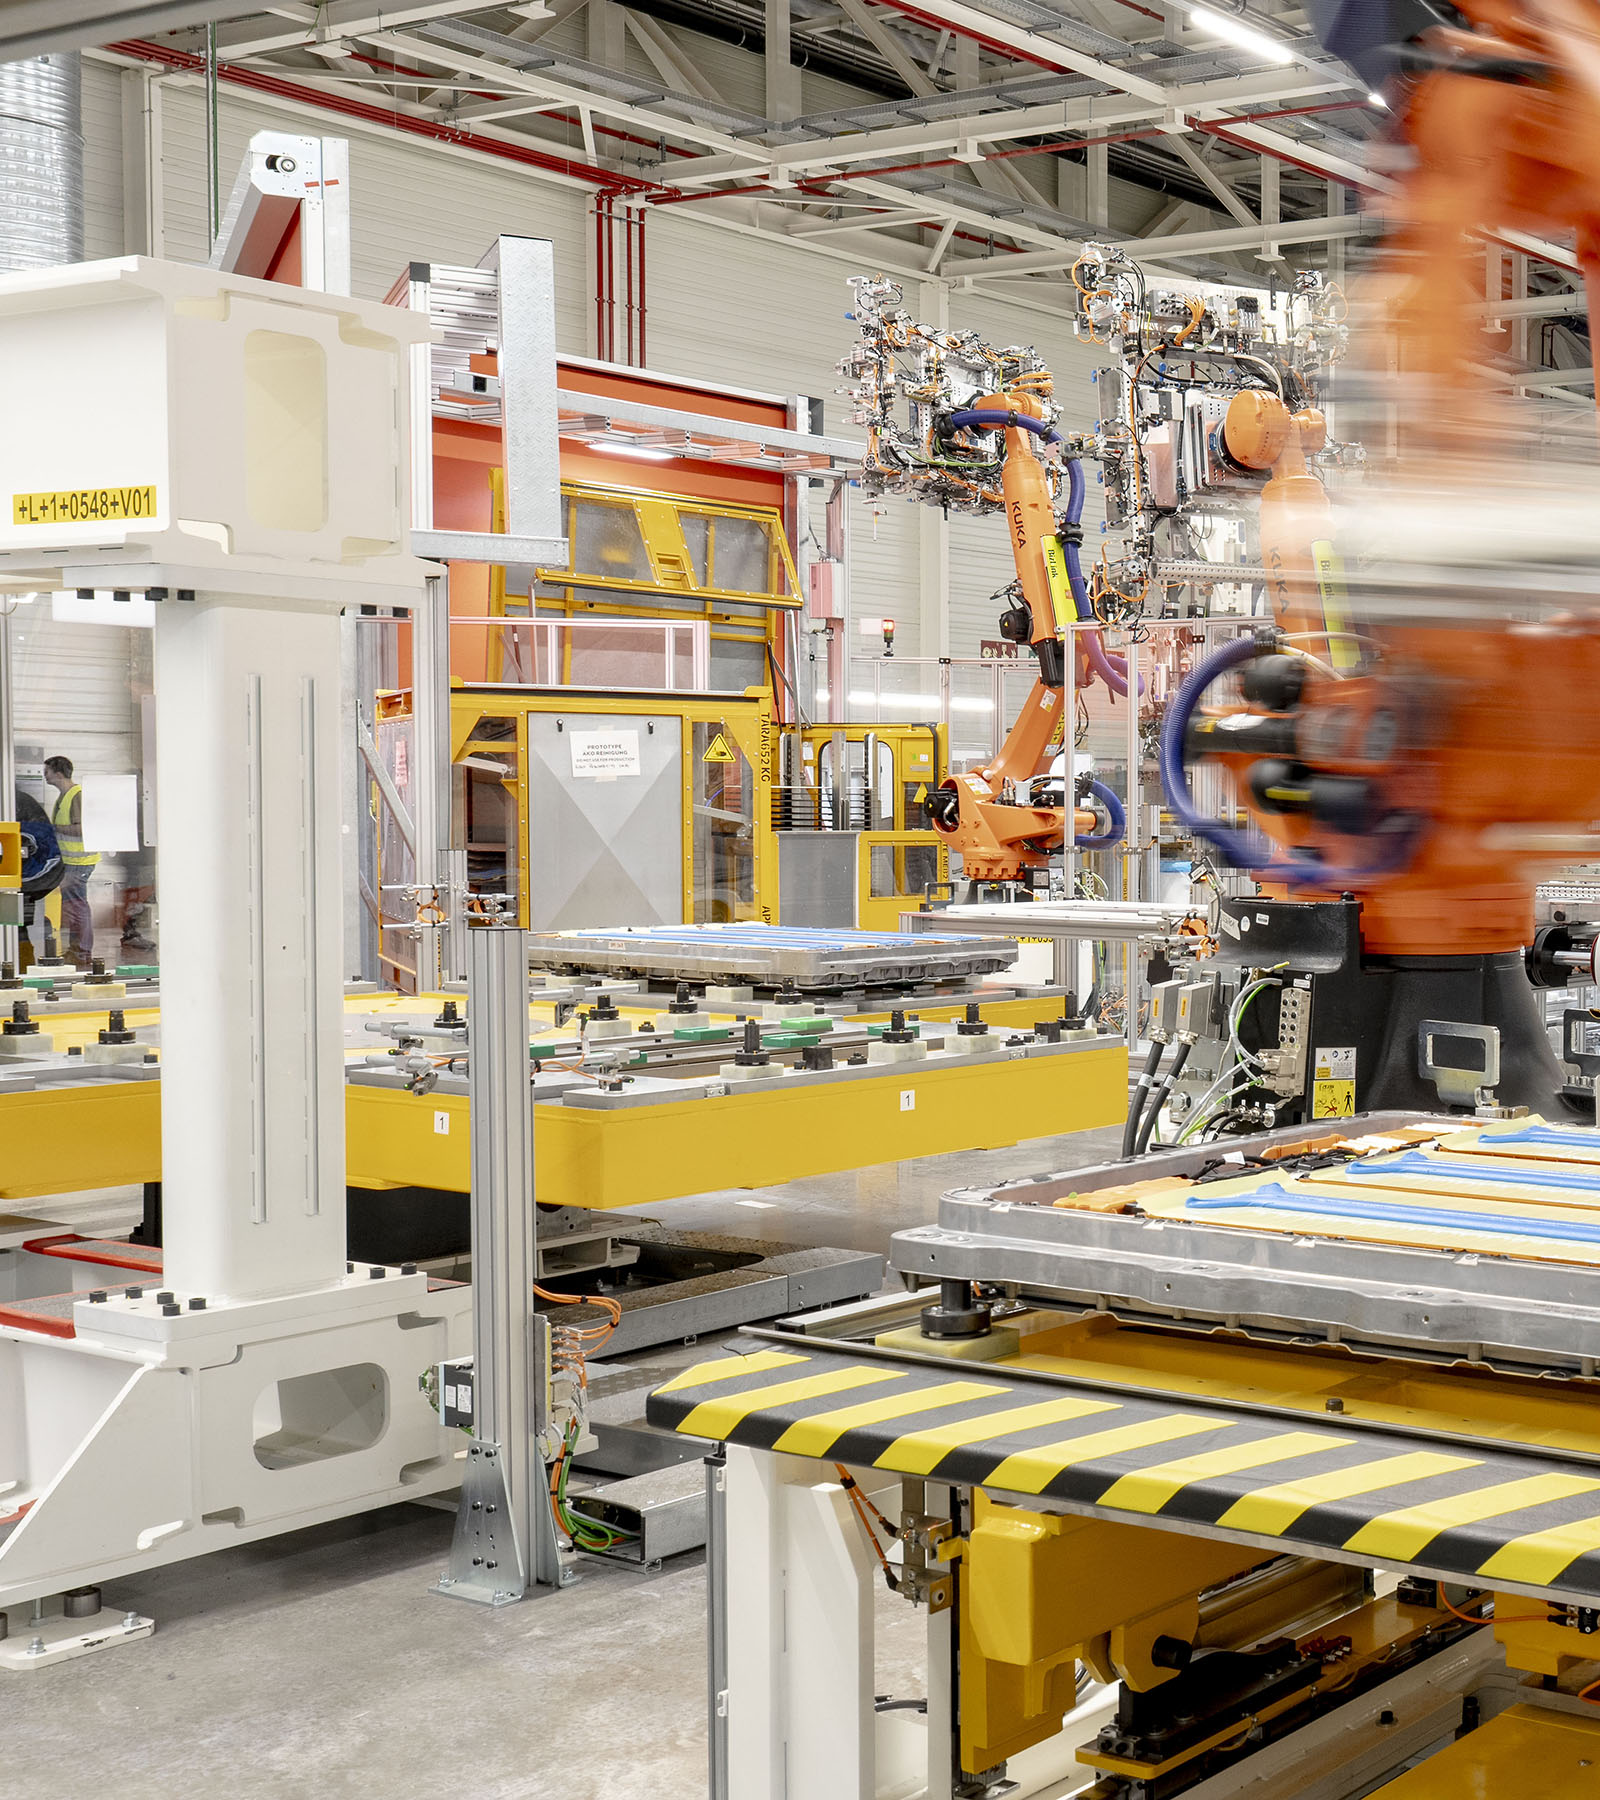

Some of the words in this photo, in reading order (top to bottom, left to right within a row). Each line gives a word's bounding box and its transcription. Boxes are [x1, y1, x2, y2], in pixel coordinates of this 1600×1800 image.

[19, 488, 151, 522] +L+1+0548+V01
[1011, 501, 1027, 549] KUKA
[760, 766, 772, 783] KG
[906, 1094, 910, 1107] 1
[439, 1116, 444, 1130] 1
